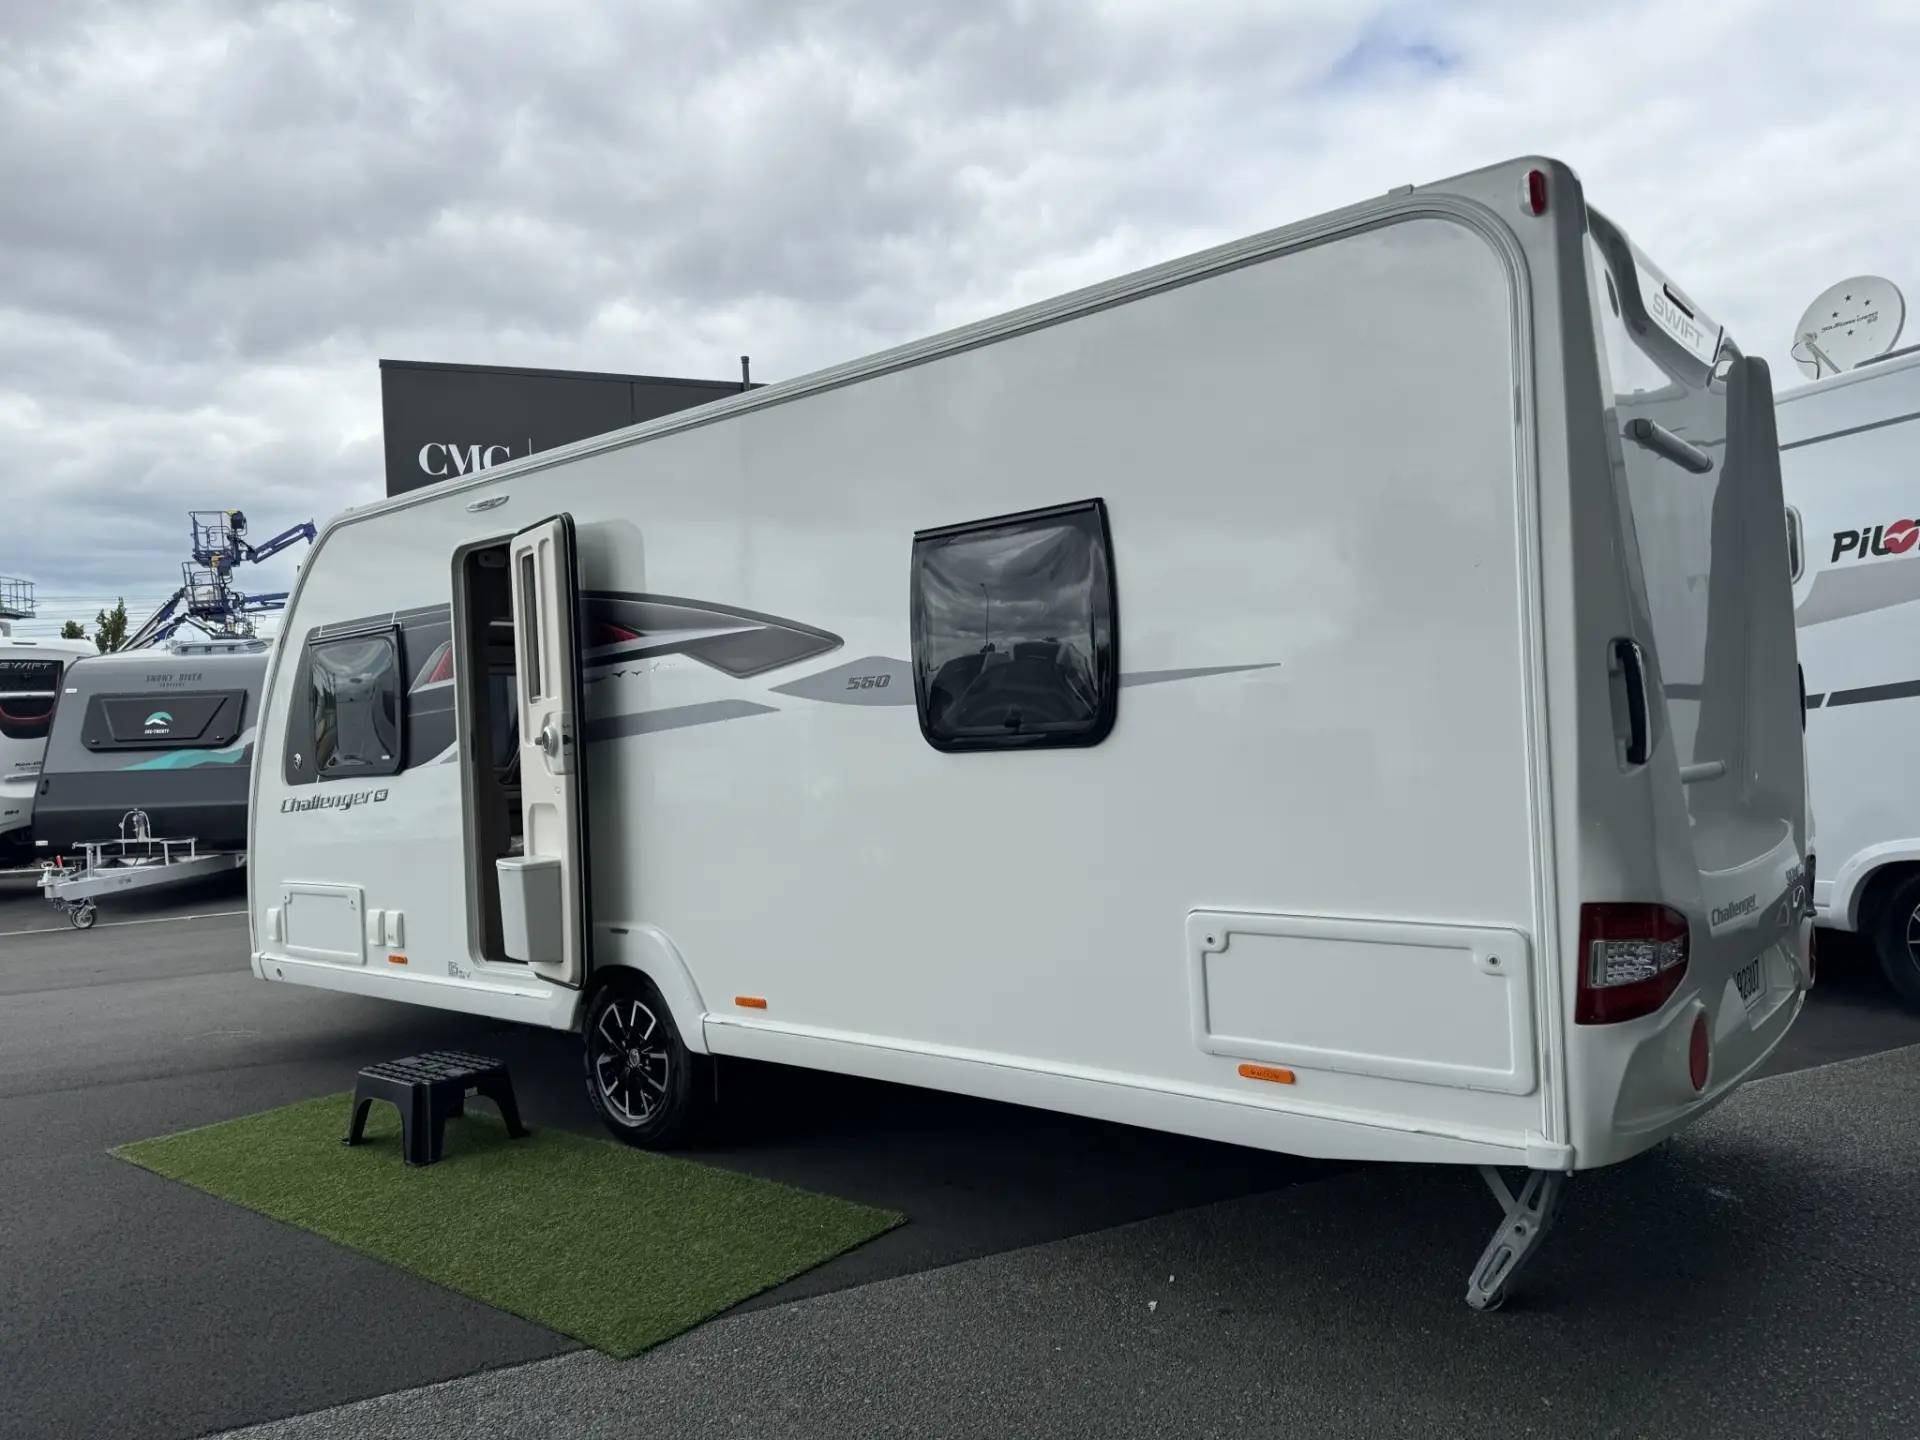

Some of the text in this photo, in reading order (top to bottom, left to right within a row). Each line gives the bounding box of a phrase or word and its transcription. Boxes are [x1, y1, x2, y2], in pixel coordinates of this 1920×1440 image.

[1652, 292, 1704, 348] SWIFT
[418, 442, 510, 476] CMC
[846, 674, 891, 690] 560
[280, 790, 388, 813] Challenger SE
[1711, 893, 1757, 926] Challenger
